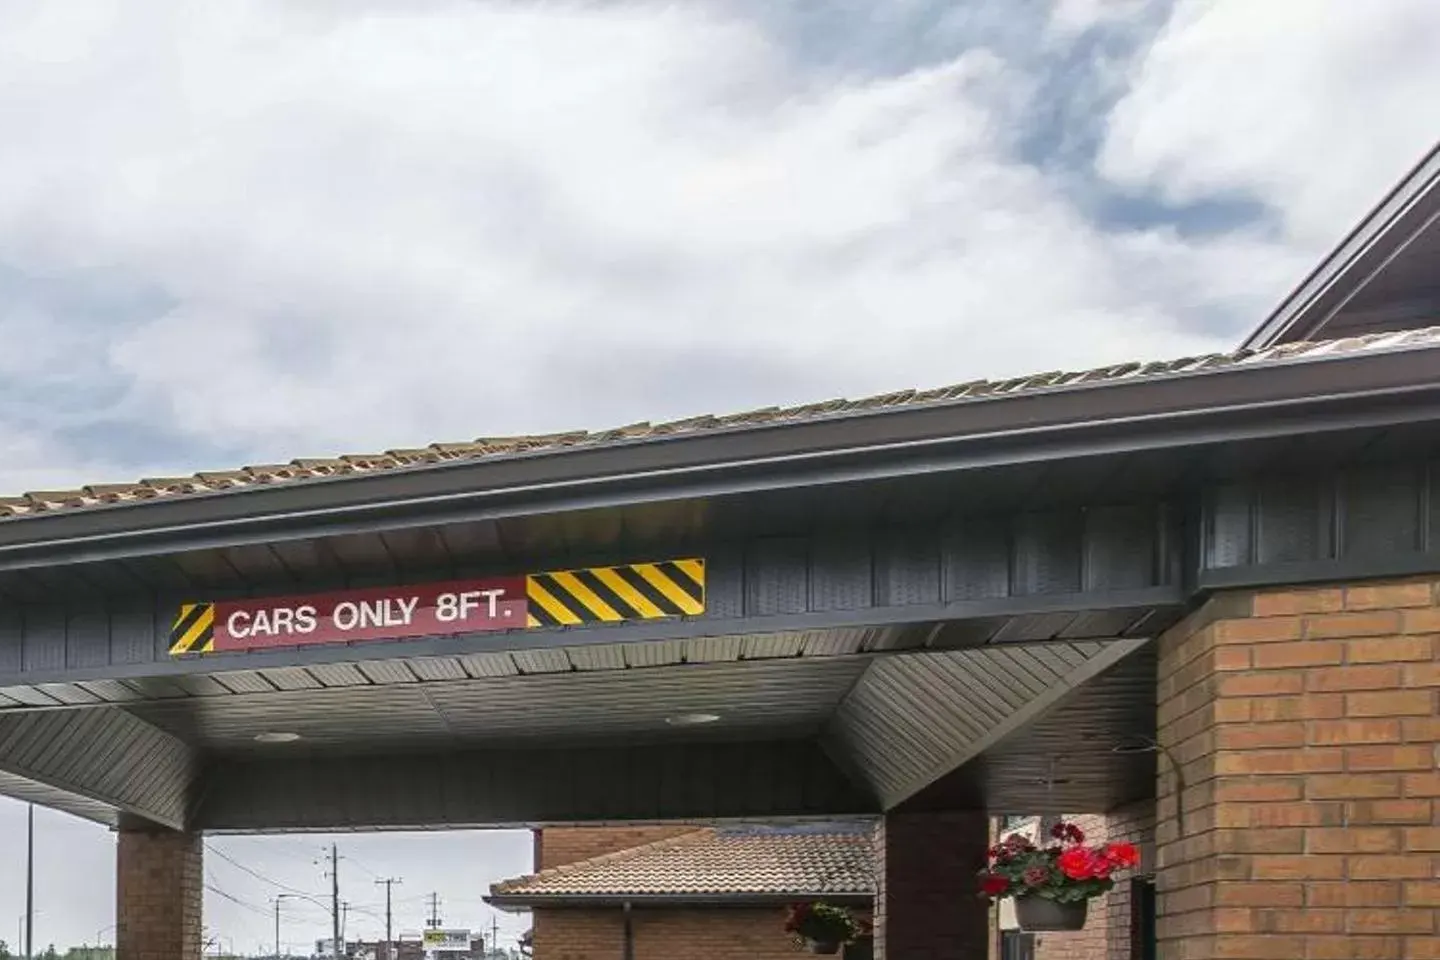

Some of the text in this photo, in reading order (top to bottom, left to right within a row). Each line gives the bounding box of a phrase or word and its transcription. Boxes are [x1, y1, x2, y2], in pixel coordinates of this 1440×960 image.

[227, 589, 512, 638] CARS ONLY 8FT.
